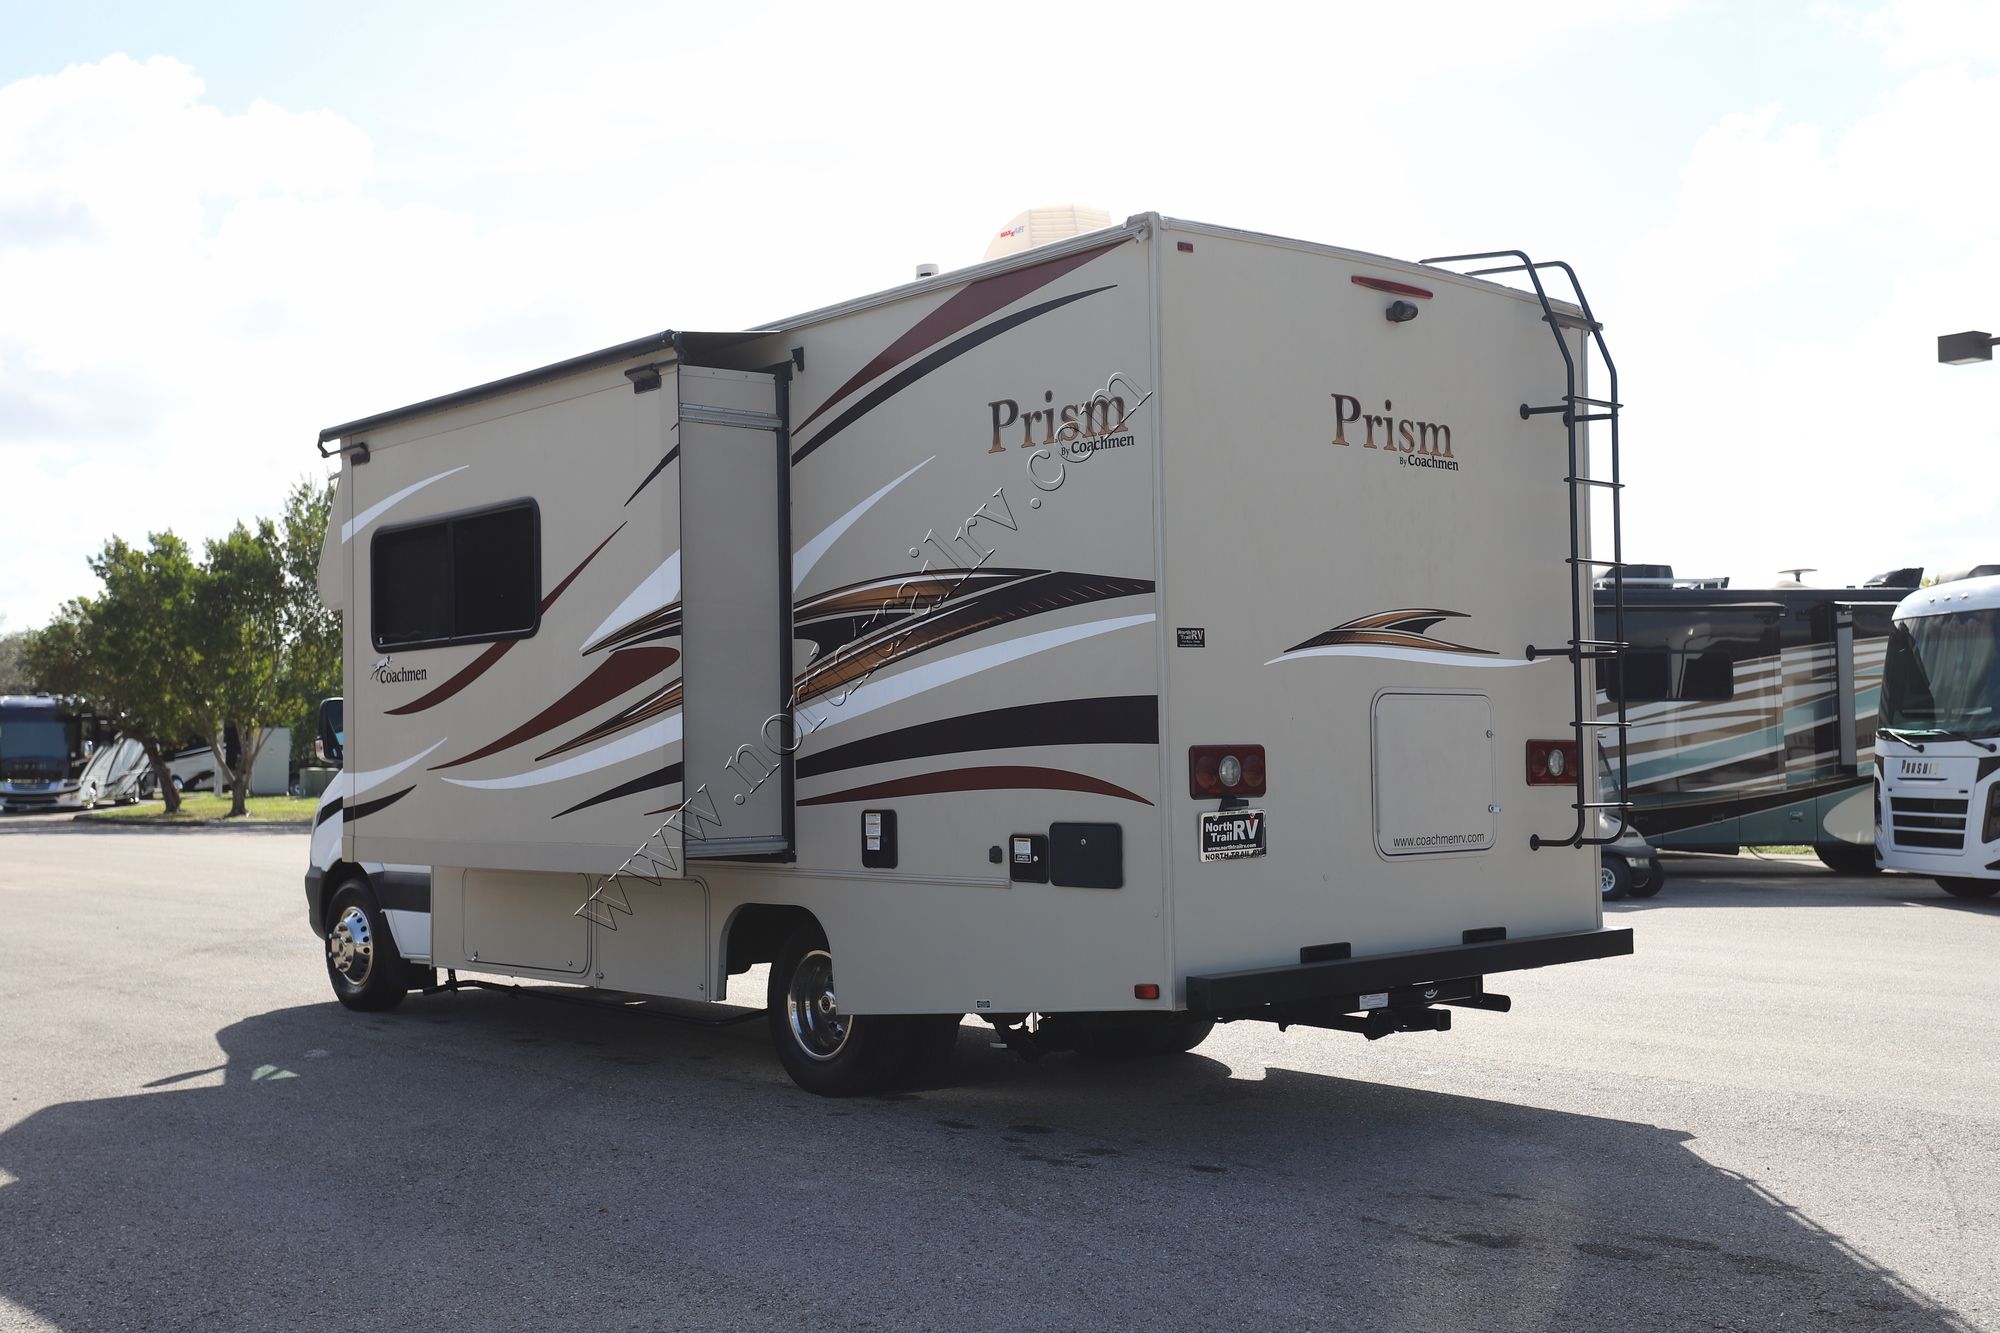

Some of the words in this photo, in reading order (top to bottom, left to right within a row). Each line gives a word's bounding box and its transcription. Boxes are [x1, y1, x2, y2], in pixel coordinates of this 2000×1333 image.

[988, 390, 1128, 454] Prism
[1331, 393, 1454, 458] Prism
[1061, 446, 1070, 457] By
[1071, 435, 1135, 454] Coachmen
[1400, 457, 1407, 467] By
[1408, 455, 1459, 471] Coachmen
[1191, 630, 1204, 640] RV
[380, 667, 427, 684] Coachmen
[1205, 821, 1232, 832] North
[1210, 831, 1232, 842] Trail
[1233, 819, 1259, 841] RV
[1393, 833, 1485, 847] www.coachmenrv.com
[1205, 852, 1229, 861] NORTH
